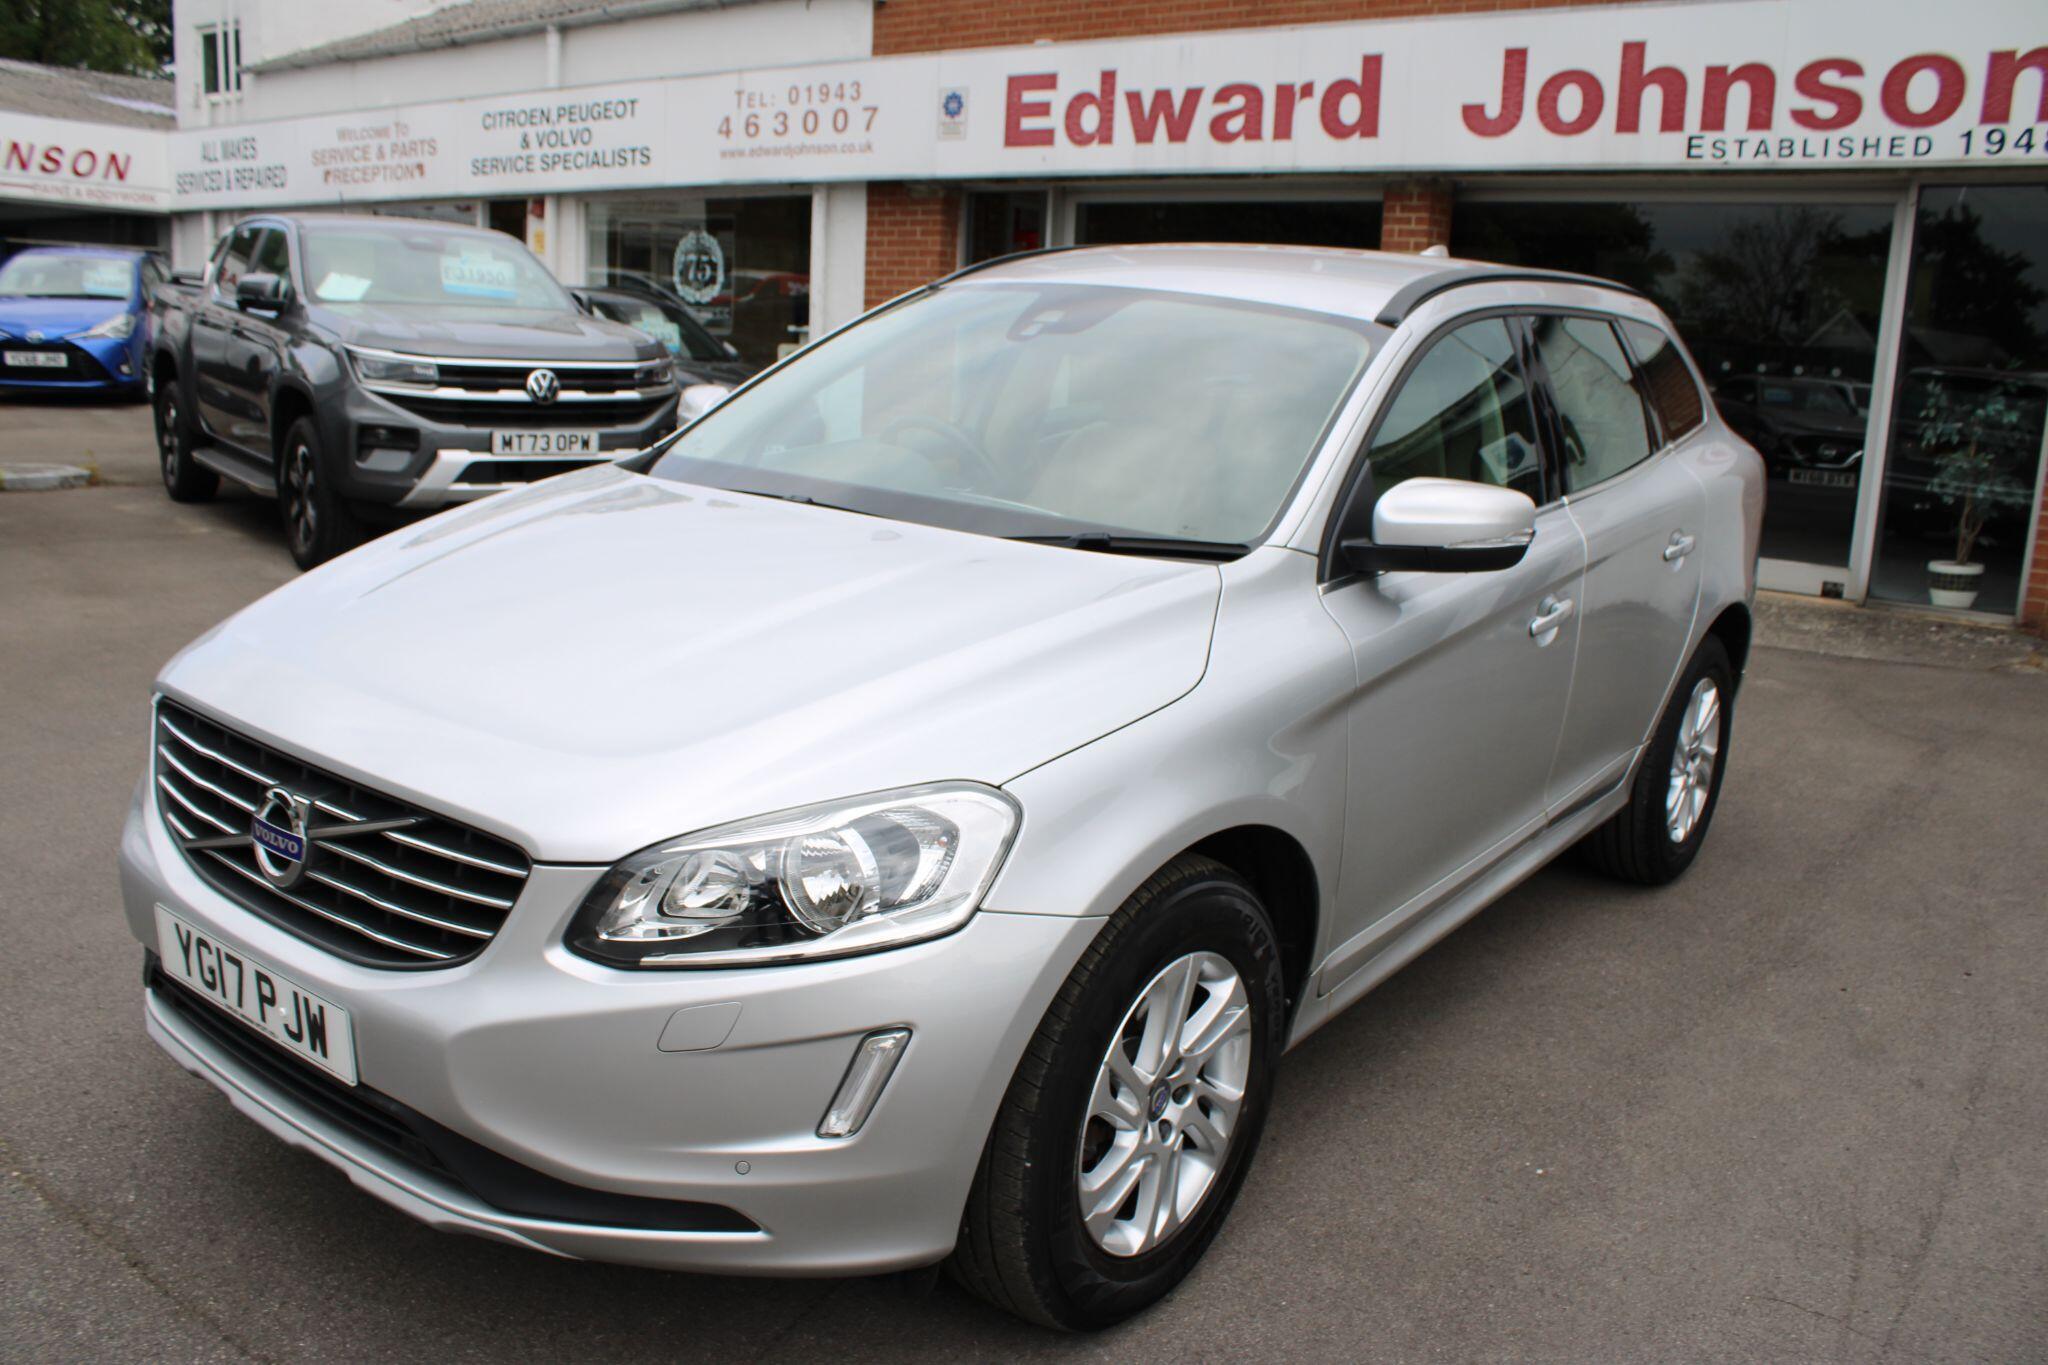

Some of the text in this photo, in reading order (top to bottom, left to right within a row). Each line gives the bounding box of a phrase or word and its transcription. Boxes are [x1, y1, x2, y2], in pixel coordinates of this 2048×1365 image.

[734, 80, 862, 109] TEL: 01943
[1003, 40, 2048, 148] Edward Johnson
[202, 136, 257, 162] ALL MAKES
[312, 137, 438, 167] SERVICE & PARTS
[520, 127, 592, 150] & VOLVO
[1686, 128, 2048, 159] ESTABLISHED 194
[471, 147, 651, 176] SERVICE SPECIALISTS
[177, 170, 222, 195] SERVICED
[235, 165, 287, 192] REPAIRED
[501, 433, 591, 452] MT73 OPW
[253, 820, 299, 855] VOLVO
[174, 921, 329, 1060] YG17 PJW
